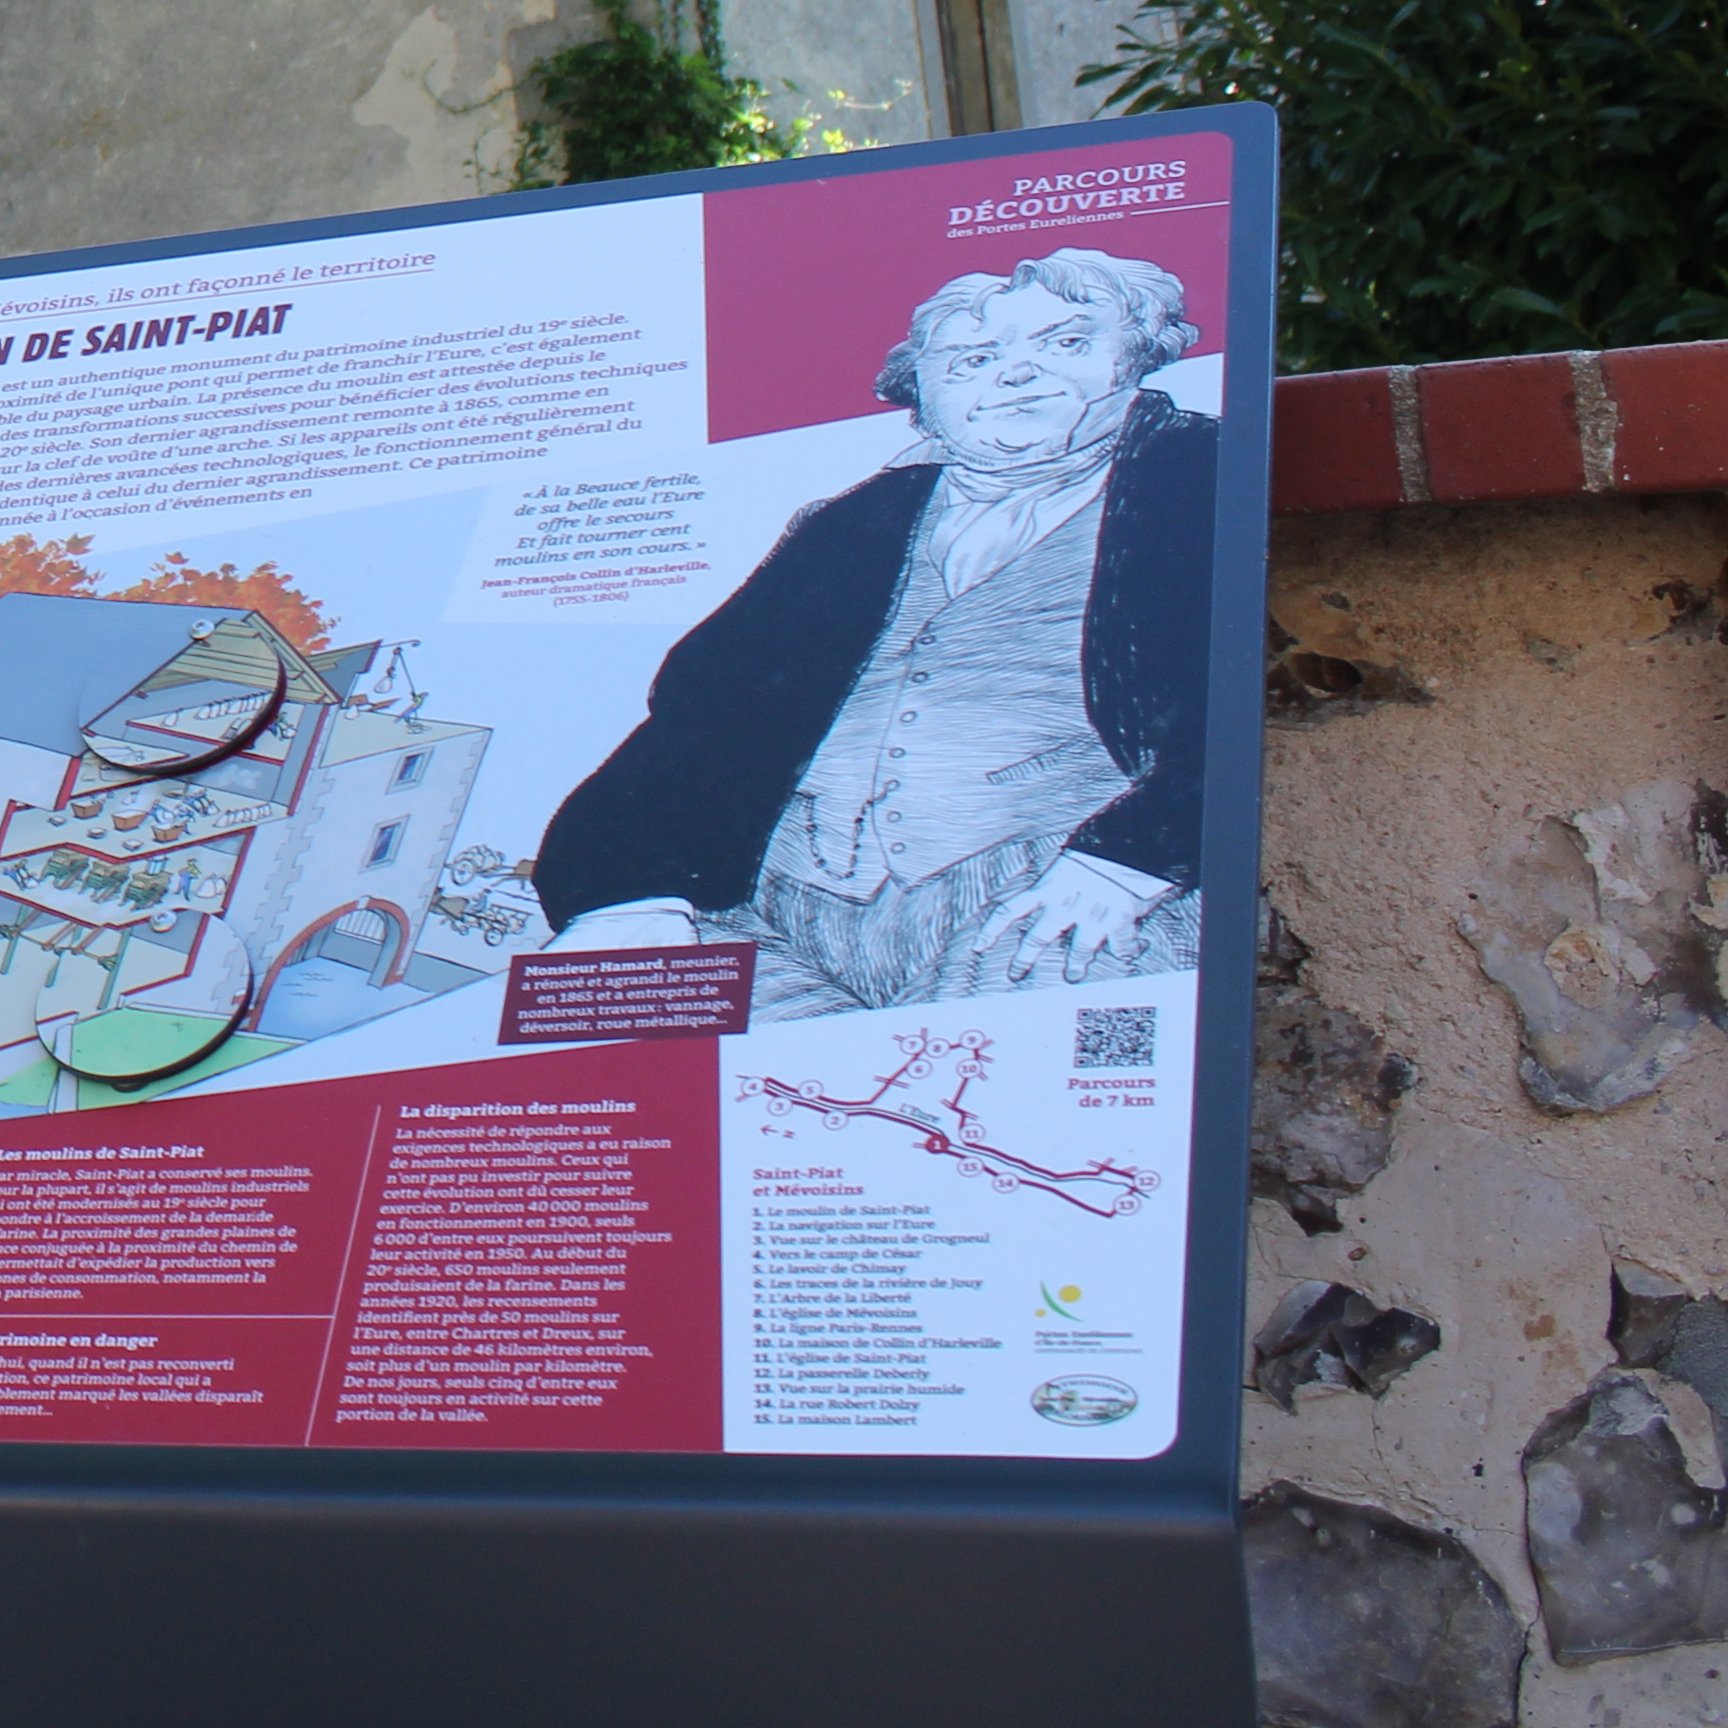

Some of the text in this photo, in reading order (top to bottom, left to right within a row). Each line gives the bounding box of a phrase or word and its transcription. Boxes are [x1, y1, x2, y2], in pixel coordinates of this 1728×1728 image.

[1013, 160, 1186, 195] PARCOURS
[947, 181, 1185, 224] DÉCOUVERTE
[947, 226, 972, 237] des
[977, 221, 1025, 234] Portes
[107, 288, 134, 303] ils
[140, 281, 182, 299] ont
[186, 269, 286, 295] façonné
[291, 267, 313, 281] le
[320, 253, 436, 275] territoire
[20, 329, 75, 362] DE
[79, 304, 293, 356] SAINT-PIAT
[2, 378, 27, 392] est
[31, 378, 53, 389] un
[58, 365, 166, 386] authentique
[170, 351, 272, 373] monument
[275, 349, 298, 362] du
[303, 339, 407, 362] patrimoine
[411, 325, 505, 346] industriel
[508, 323, 533, 336] du
[570, 313, 628, 329] siècle.
[65, 389, 87, 401] de
[167, 375, 210, 394] pont
[212, 371, 242, 389] qui
[246, 363, 314, 385] permet
[316, 362, 340, 374] de
[343, 353, 422, 371] franchir
[538, 327, 642, 352] également
[553, 485, 571, 496] la
[574, 480, 640, 494] Beauce
[642, 474, 700, 491] fertile,
[514, 504, 535, 516] de
[540, 504, 560, 514] sa
[566, 498, 608, 511] belle
[612, 496, 646, 507] eau
[537, 510, 674, 532] offre le secours
[517, 522, 690, 549] Et fait tourner cent
[494, 551, 568, 567] moulins
[573, 550, 595, 560] en
[600, 546, 632, 557] son
[637, 542, 689, 554] cours.
[524, 964, 596, 976] Monsieur
[534, 977, 583, 989] rénové
[587, 976, 601, 987] et
[605, 973, 663, 987] agrandi
[666, 973, 680, 982] le
[683, 970, 737, 981] moulin
[537, 995, 555, 1003] en
[560, 991, 593, 1002] 1865
[596, 990, 610, 1000] et
[626, 986, 696, 999] entrepris
[699, 985, 717, 995] de
[517, 1007, 595, 1018] nombreux
[664, 1001, 733, 1011] vannage,
[596, 1020, 631, 1029] roue
[1067, 1078, 1155, 1089] Parcours
[400, 1101, 635, 1119] La disparition des moulins
[1077, 1095, 1155, 1107] de 7 km
[395, 1125, 610, 1139] La nécessité de répondre aux
[24, 1148, 92, 1159] moulins
[95, 1147, 116, 1158] de
[118, 1146, 204, 1158] Saint-Piat
[15, 1169, 70, 1181] miracle,
[74, 1168, 145, 1179] Saint-Piat
[158, 1167, 223, 1178] conservé
[249, 1166, 311, 1177] moulins.
[2, 1288, 83, 1301] parisienne.
[69, 1337, 90, 1346] en
[94, 1335, 156, 1349] danger
[777, 1338, 794, 1347] La
[27, 1358, 75, 1371] quand
[76, 1358, 88, 1368] il
[127, 1361, 154, 1372] pas
[156, 1359, 234, 1369] reconverti
